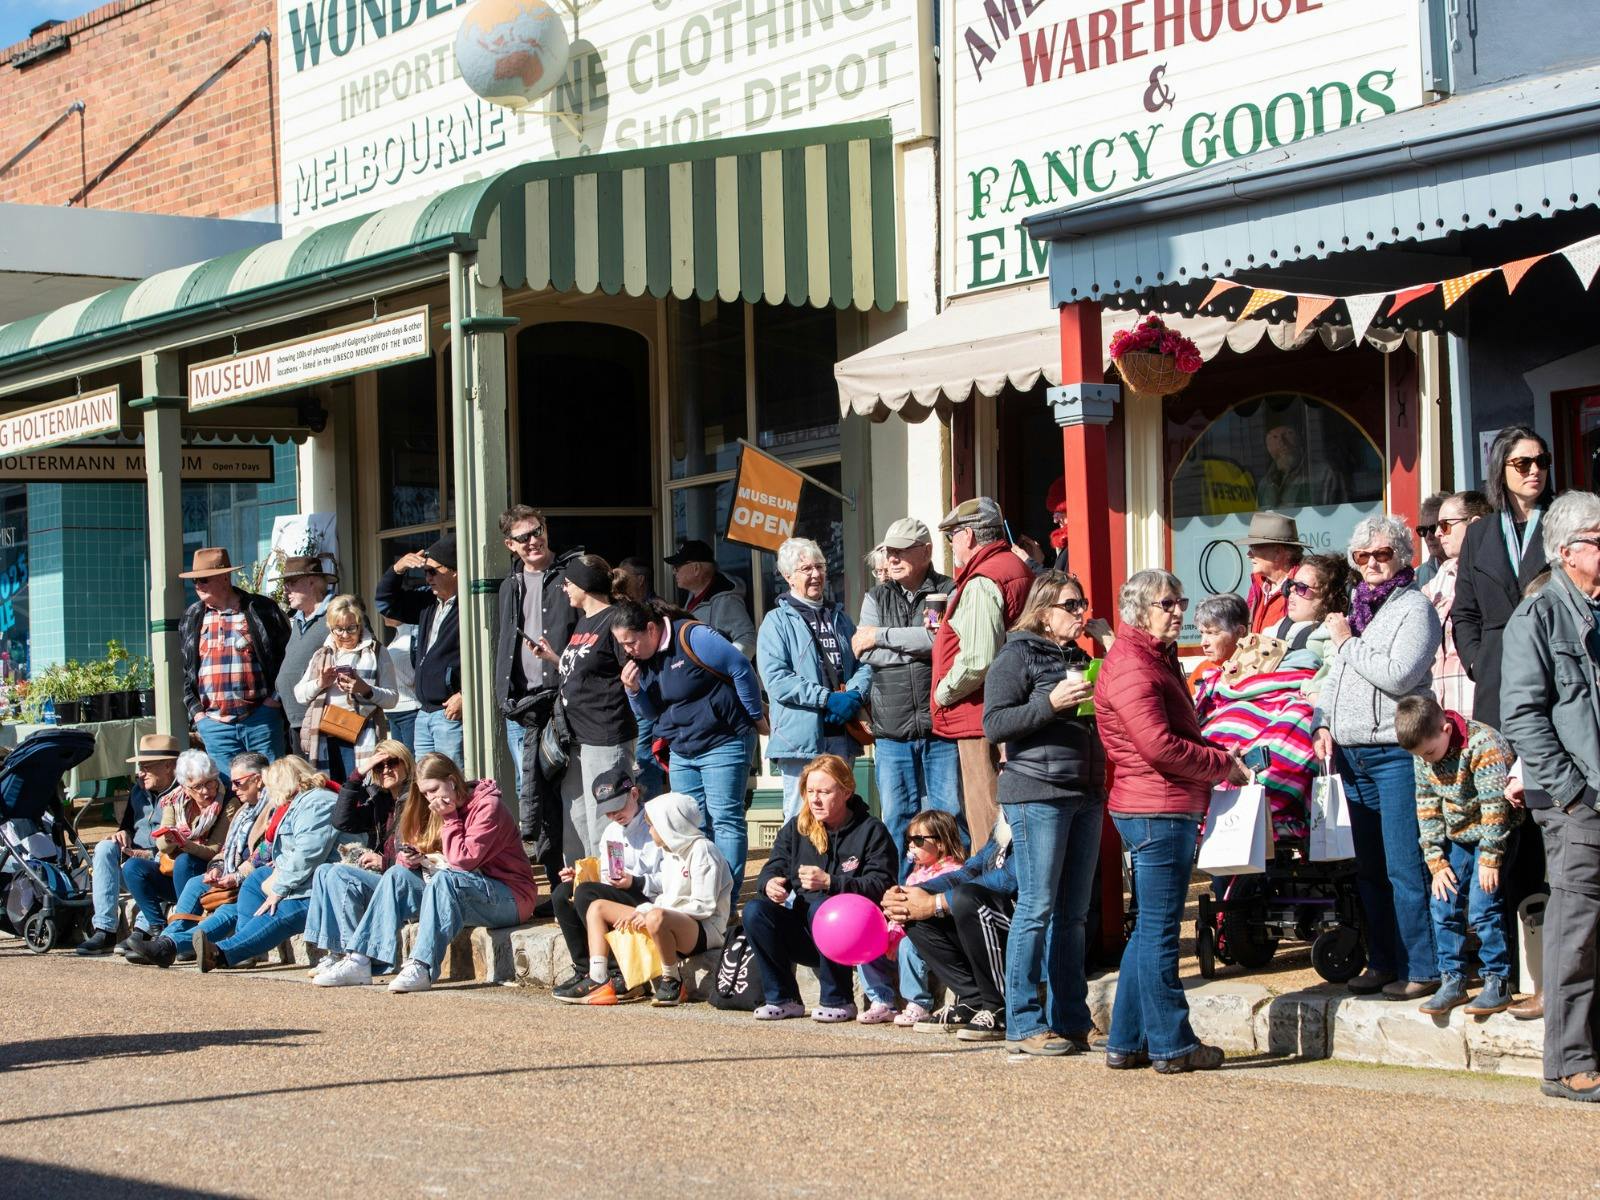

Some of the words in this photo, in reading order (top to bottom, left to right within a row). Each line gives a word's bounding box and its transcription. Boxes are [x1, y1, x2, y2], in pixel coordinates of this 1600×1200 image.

[289, 0, 467, 72] WOND
[964, 0, 1046, 83] AM
[1018, 0, 1323, 87] WAREHOU
[744, 40, 897, 131] DEPOT
[1143, 62, 1176, 113] &
[293, 98, 506, 216] MELBOURNE
[967, 124, 1164, 221] FANCY
[1181, 67, 1396, 168] GOODS
[277, 353, 296, 364] showing
[313, 341, 341, 356] photographs
[392, 327, 403, 336] days
[409, 321, 422, 331] other
[277, 366, 298, 376] locations
[302, 360, 316, 370] listed
[323, 357, 332, 365] the
[332, 350, 354, 363] UNESCO
[355, 343, 380, 357] MEMORY
[381, 341, 388, 351] OF
[390, 338, 401, 348] THE
[402, 334, 423, 346] WORLD
[195, 356, 271, 400] MUSEUM
[13, 397, 113, 444] HOLTERMANN
[0, 454, 115, 470] OLTERMANN
[212, 462, 234, 471] Open
[235, 462, 240, 470] 7
[241, 462, 260, 471] Days
[734, 506, 794, 539] OPEN
[738, 486, 798, 512] MUSEUM
